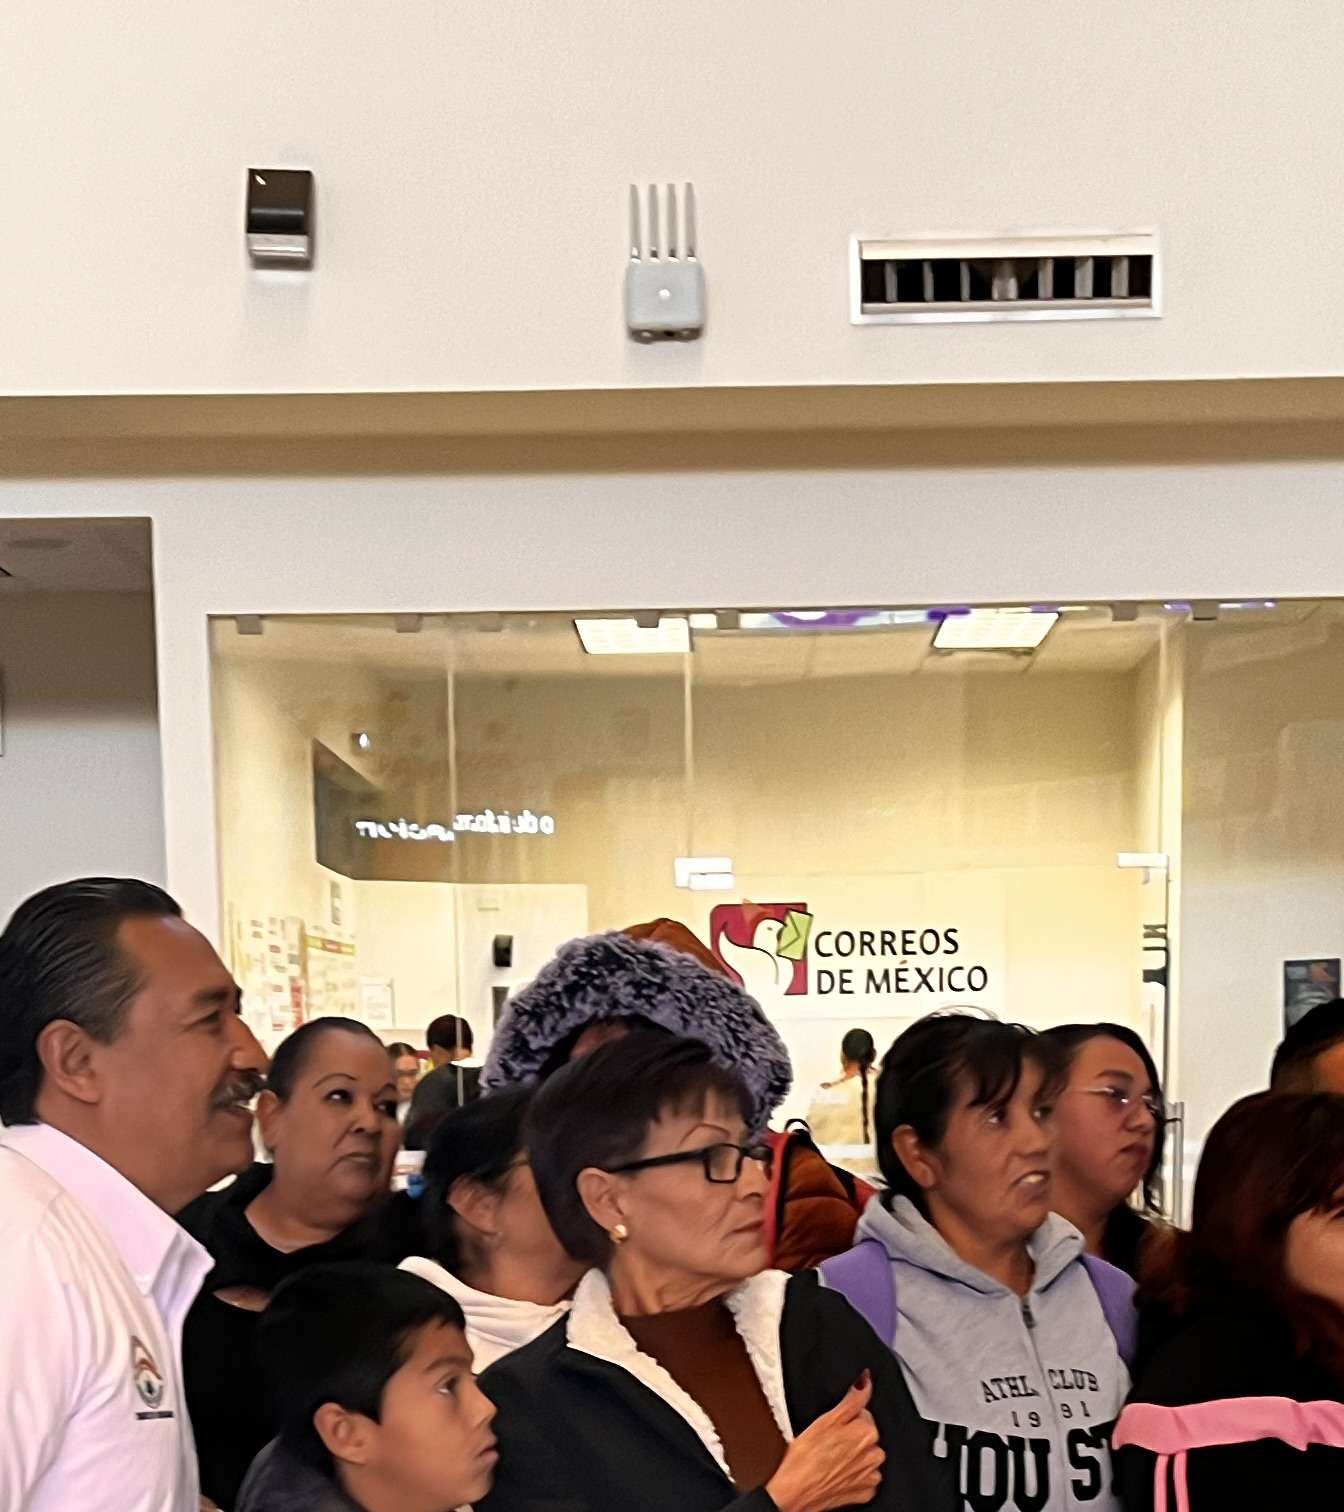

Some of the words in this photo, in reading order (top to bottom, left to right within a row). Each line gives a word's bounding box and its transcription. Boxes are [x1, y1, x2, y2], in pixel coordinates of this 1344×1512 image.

[814, 928, 959, 958] CORREOS
[817, 968, 855, 995] DE
[865, 960, 988, 994] MÉXICO
[1048, 1368, 1099, 1393] CLUB
